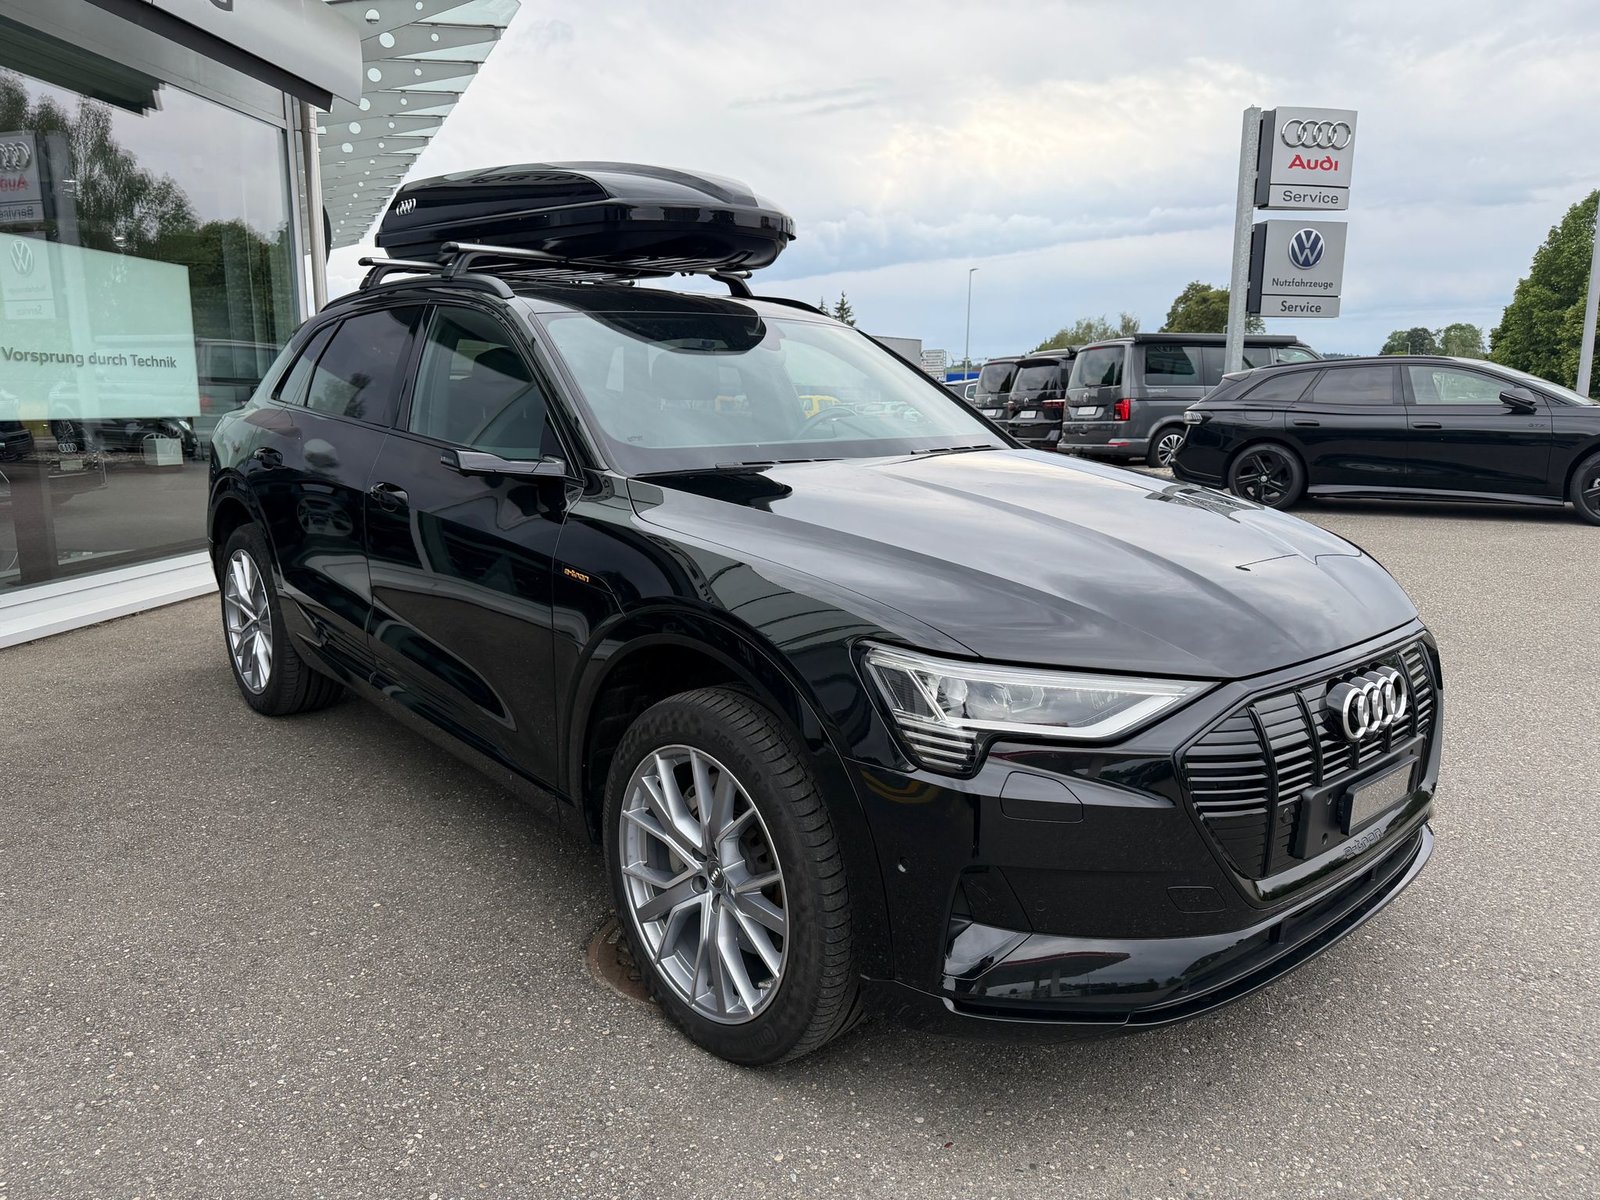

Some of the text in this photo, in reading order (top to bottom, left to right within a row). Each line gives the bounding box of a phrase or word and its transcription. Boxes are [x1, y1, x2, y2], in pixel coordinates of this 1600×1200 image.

[1288, 154, 1339, 171] Audi
[1282, 190, 1339, 204] Service
[1272, 277, 1334, 290] Nutzfahrzeuge
[1280, 300, 1322, 313] Service
[1, 346, 177, 368] Vorsprung durch Technik
[1343, 827, 1383, 858] e-tron
